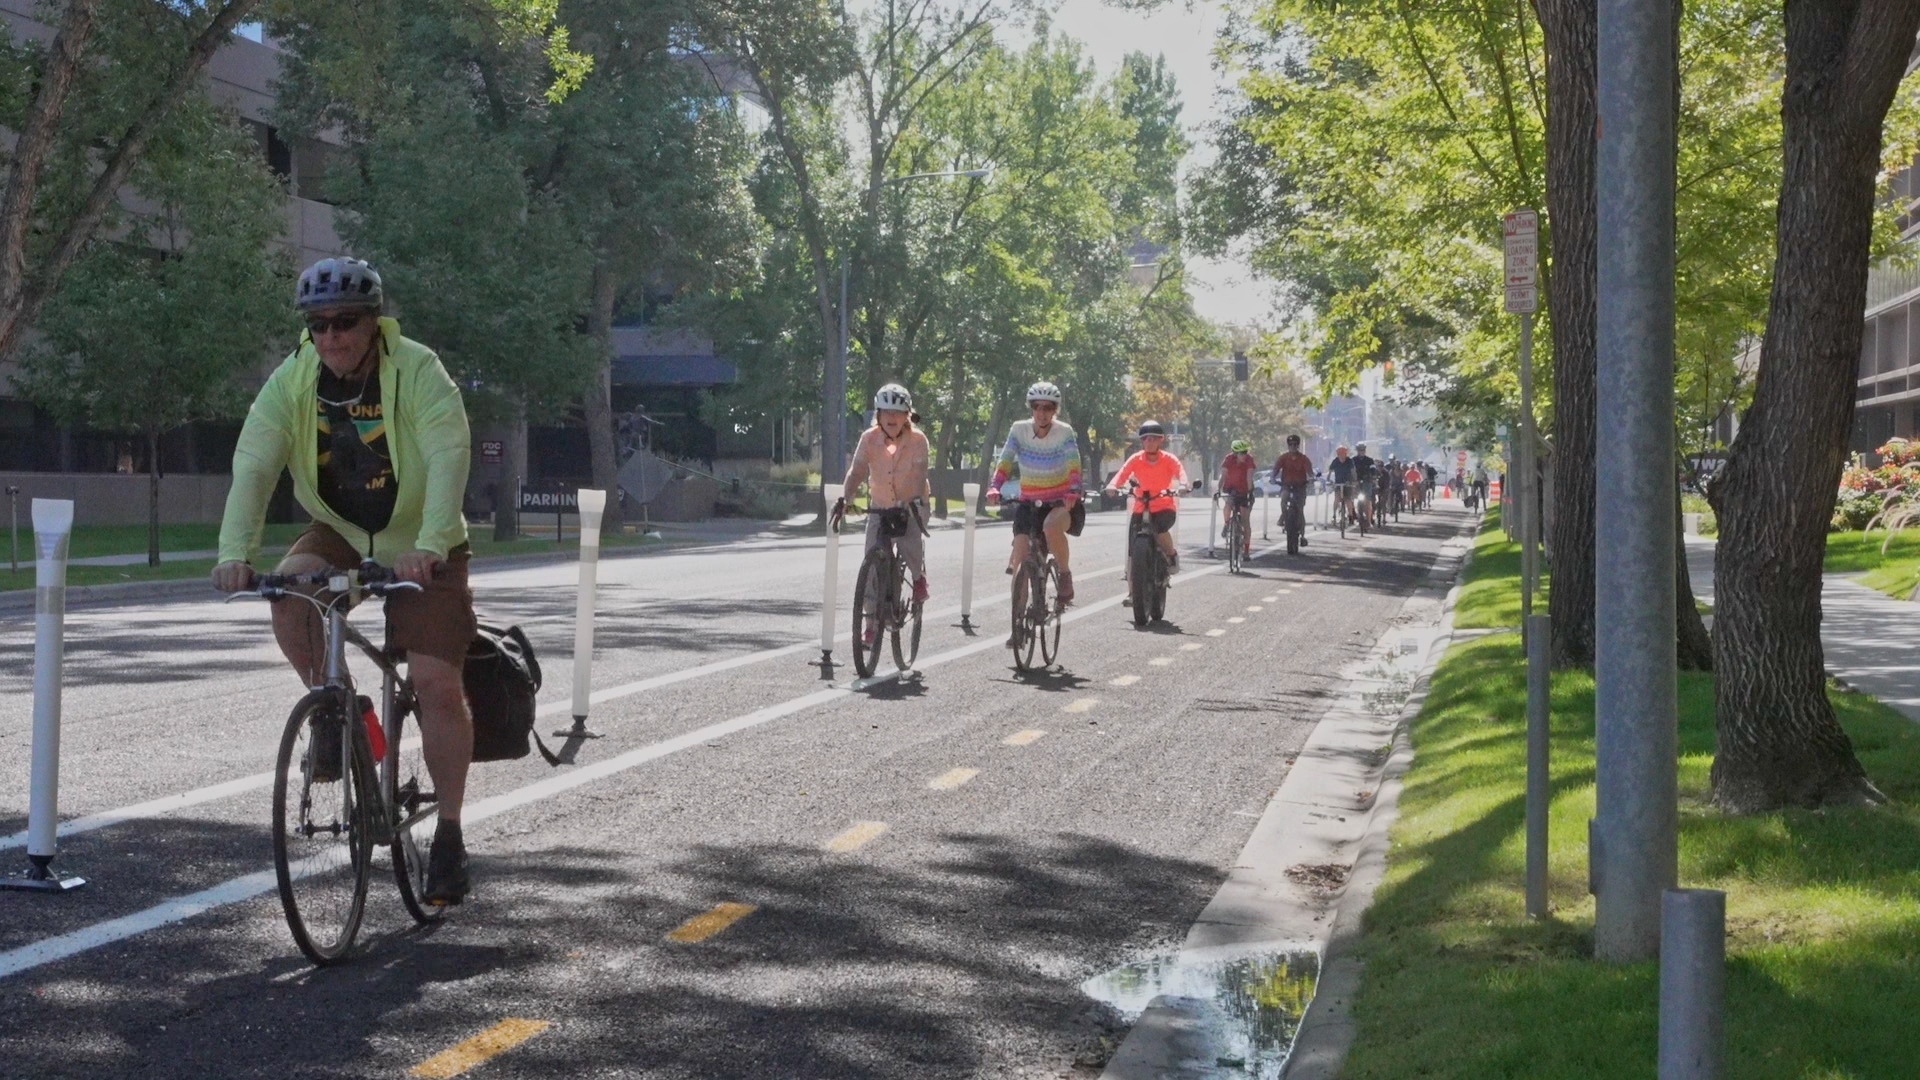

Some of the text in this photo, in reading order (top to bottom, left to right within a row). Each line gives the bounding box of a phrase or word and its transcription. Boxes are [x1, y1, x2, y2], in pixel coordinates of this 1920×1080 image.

[1506, 219, 1516, 232] NO
[1507, 245, 1534, 256] LOADING
[1512, 256, 1529, 266] ZONE
[1511, 291, 1529, 299] PERMIT
[1507, 300, 1533, 309] REQUIRED
[482, 442, 501, 450] FDC
[523, 493, 577, 506] PARKIN
